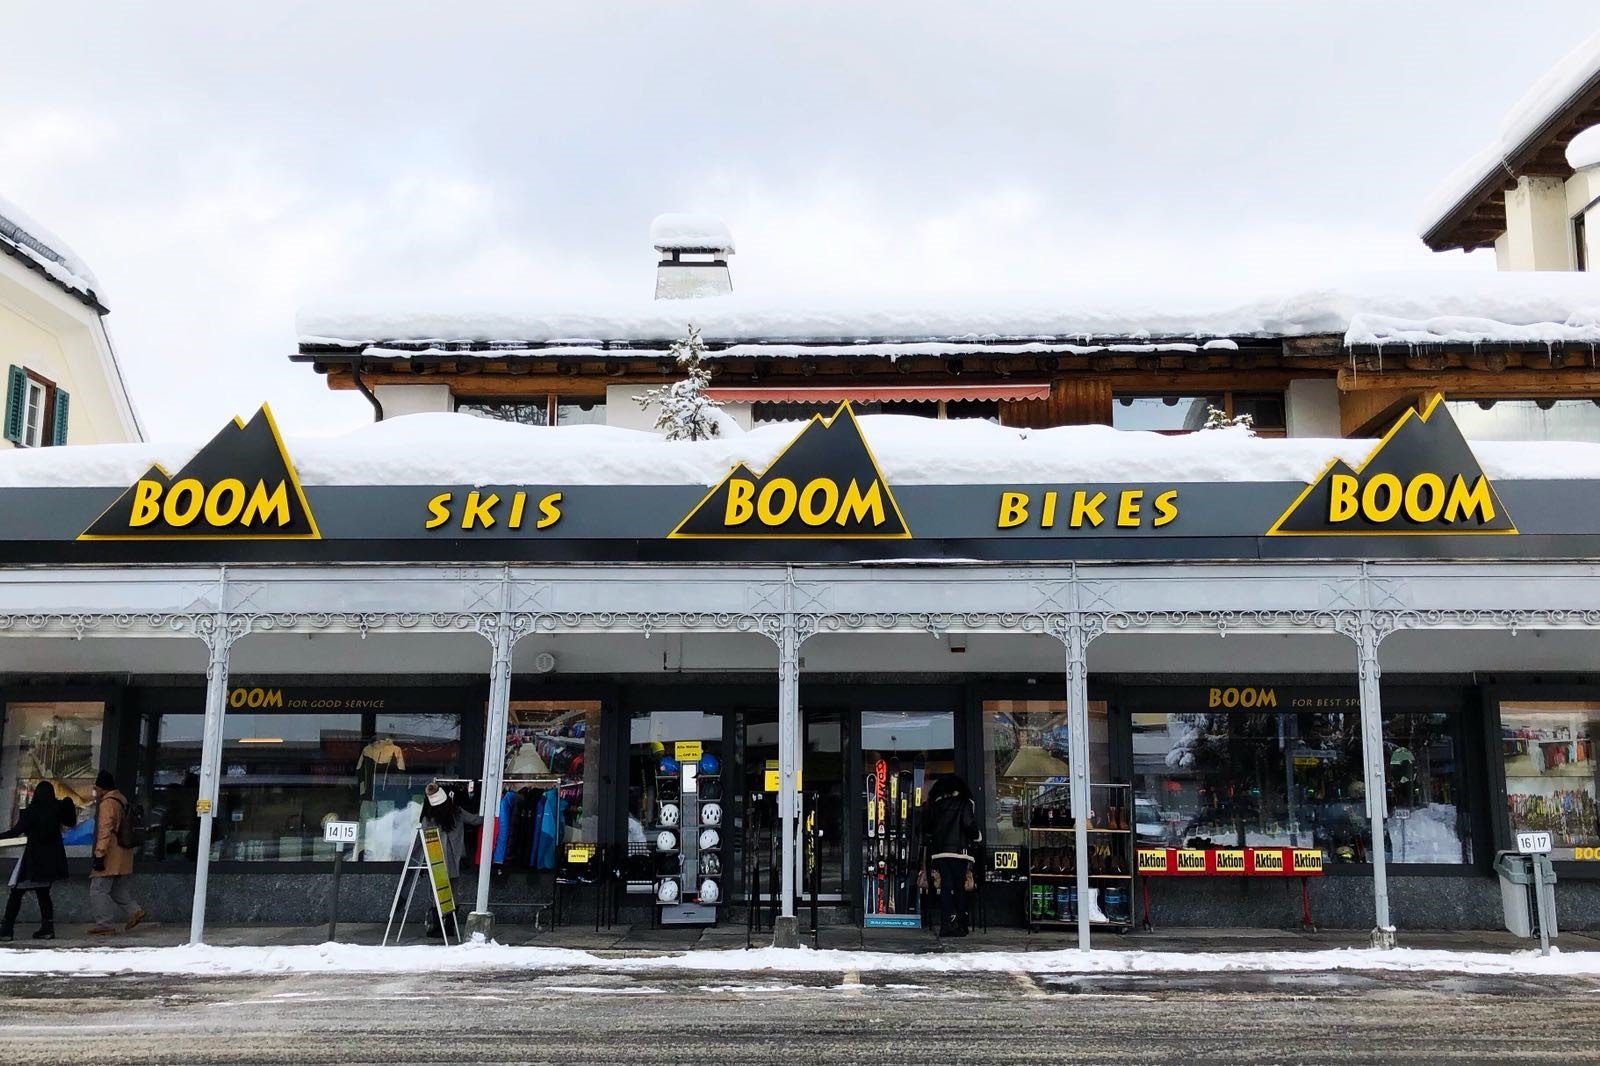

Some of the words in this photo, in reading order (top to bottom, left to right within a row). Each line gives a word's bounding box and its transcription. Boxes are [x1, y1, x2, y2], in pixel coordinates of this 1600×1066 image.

[129, 477, 291, 528] BOOM
[723, 477, 886, 528] BOOM
[1328, 472, 1497, 524] BOOM
[425, 491, 564, 530] SKIS
[997, 489, 1179, 530] BIKES
[288, 699, 308, 708] FOR
[310, 699, 342, 708] GOOD
[344, 699, 385, 708] SERVICE
[1208, 687, 1278, 708] BOOM
[1291, 698, 1313, 707] FOR
[1316, 698, 1340, 707] BEST
[329, 826, 338, 837] 14
[344, 826, 354, 838] 15
[1520, 836, 1532, 849] 16
[1536, 836, 1547, 848] 17
[995, 852, 1017, 868] 50%
[1139, 851, 1167, 868] Aktion
[1177, 851, 1205, 868] Aktion
[1216, 851, 1244, 868] Aktion
[1255, 851, 1283, 868] Aktion
[1294, 851, 1322, 868] Aktion
